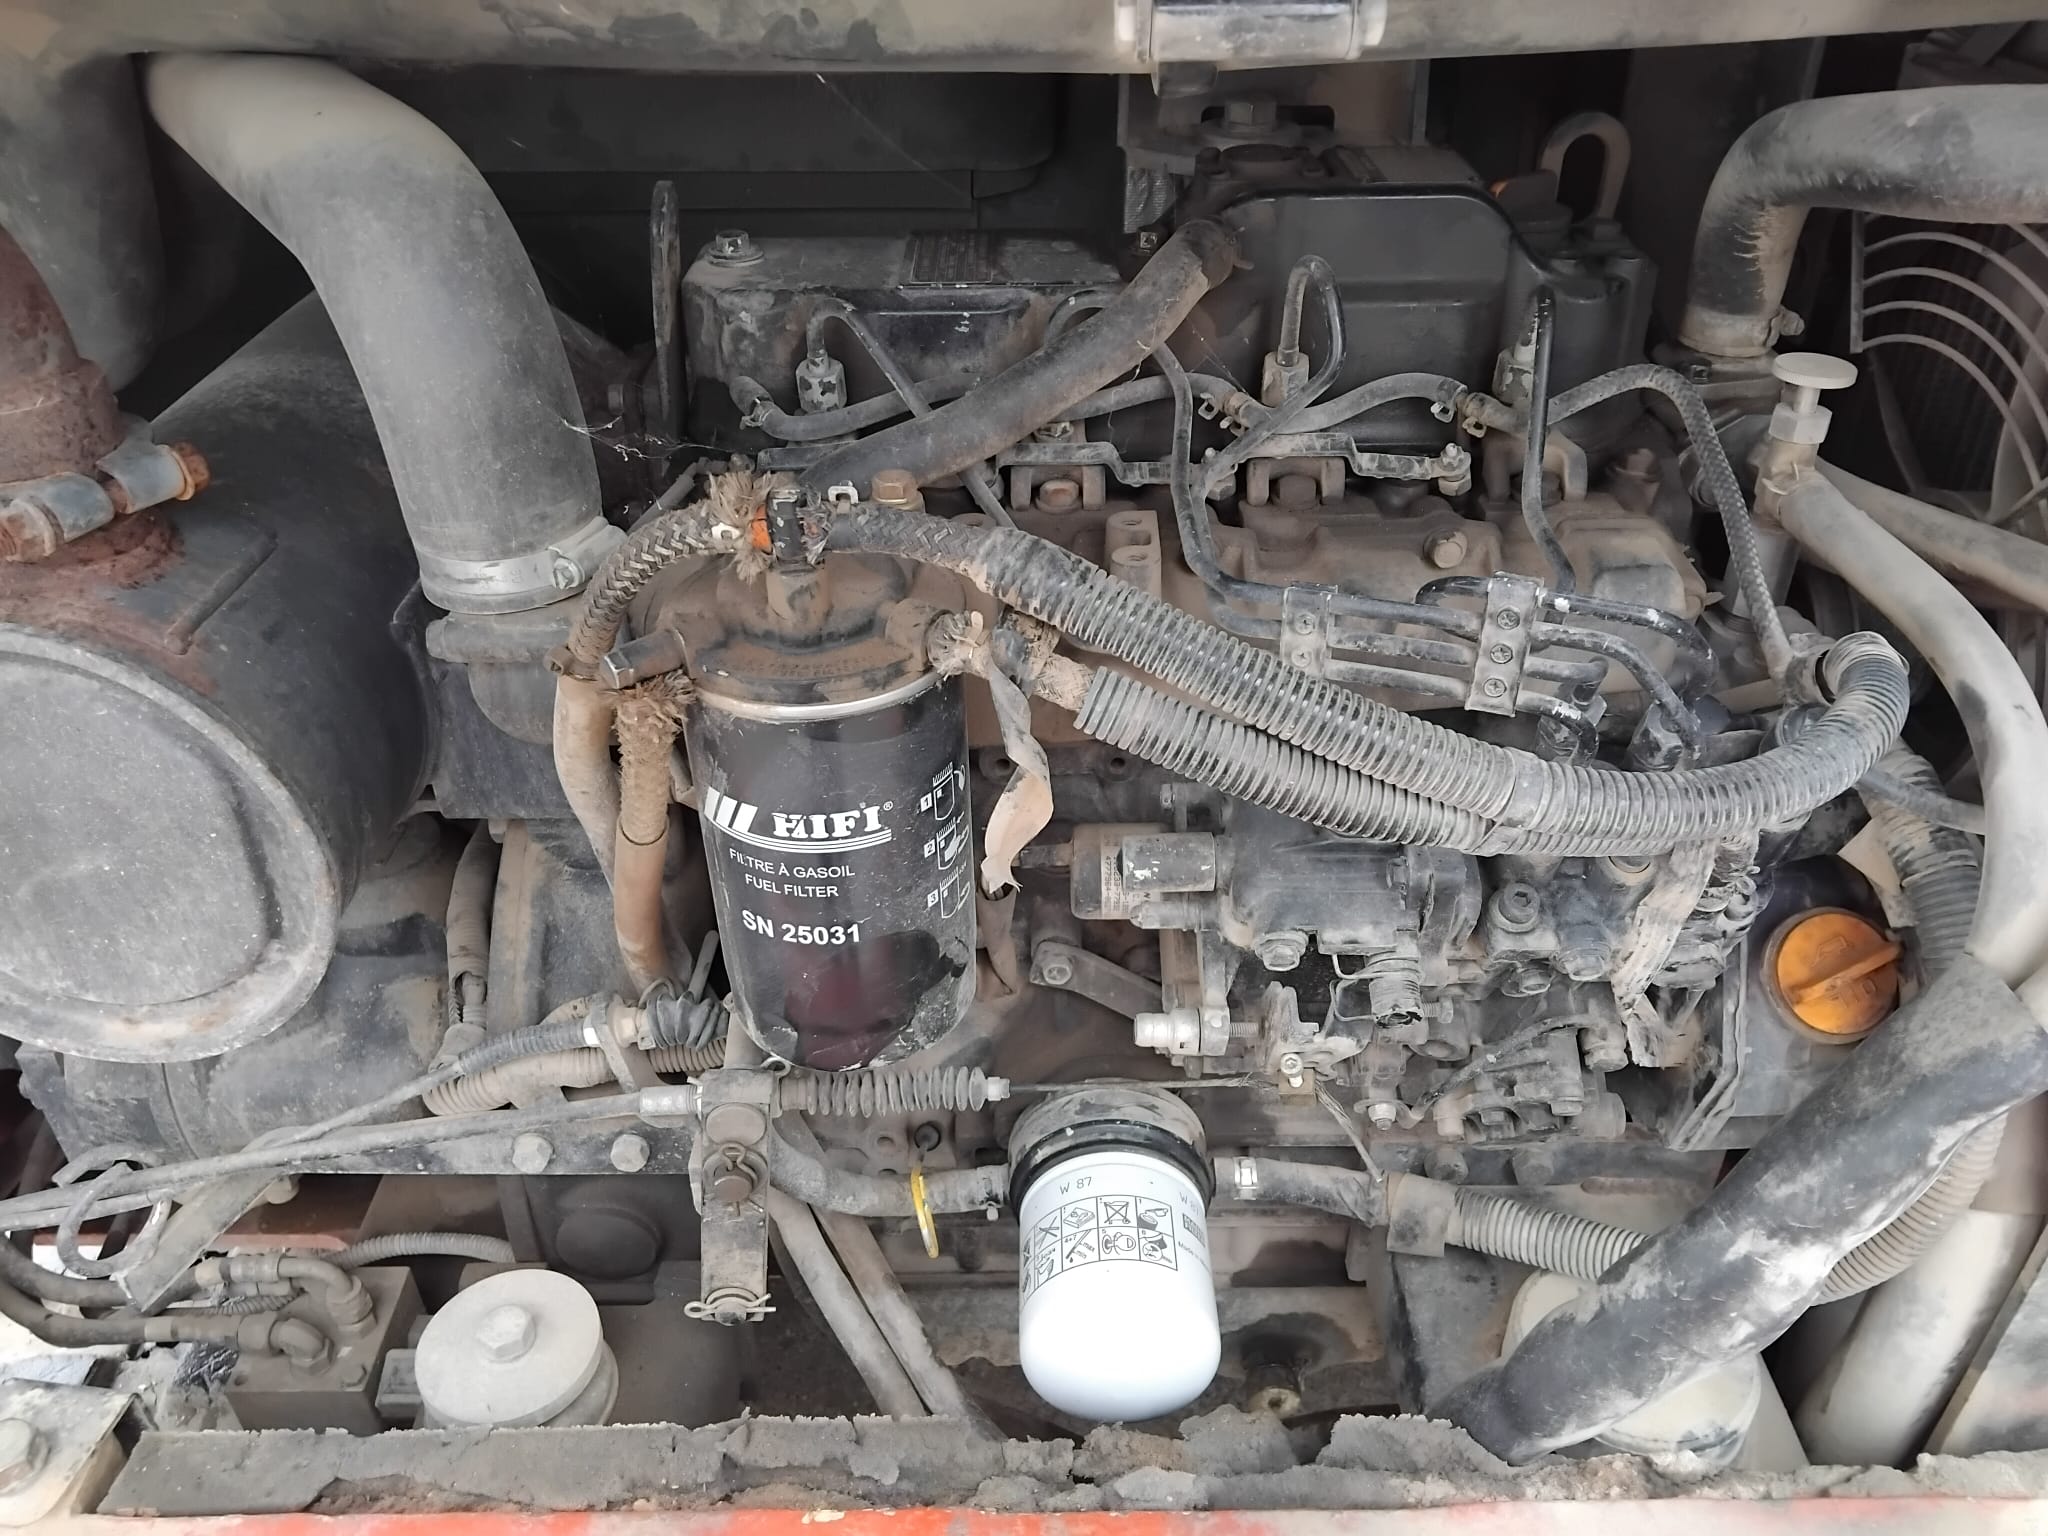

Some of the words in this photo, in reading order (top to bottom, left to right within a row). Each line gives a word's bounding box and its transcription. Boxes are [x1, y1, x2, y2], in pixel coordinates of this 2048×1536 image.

[729, 848, 775, 874] FILTRE
[778, 862, 790, 877] À
[793, 865, 855, 879] GASOIL
[745, 873, 781, 894] FUEL
[784, 884, 839, 898] FILTER
[742, 909, 775, 938] SN
[781, 923, 860, 945] 25031
[1060, 1182, 1070, 1195] W
[1076, 1176, 1092, 1190] 87
